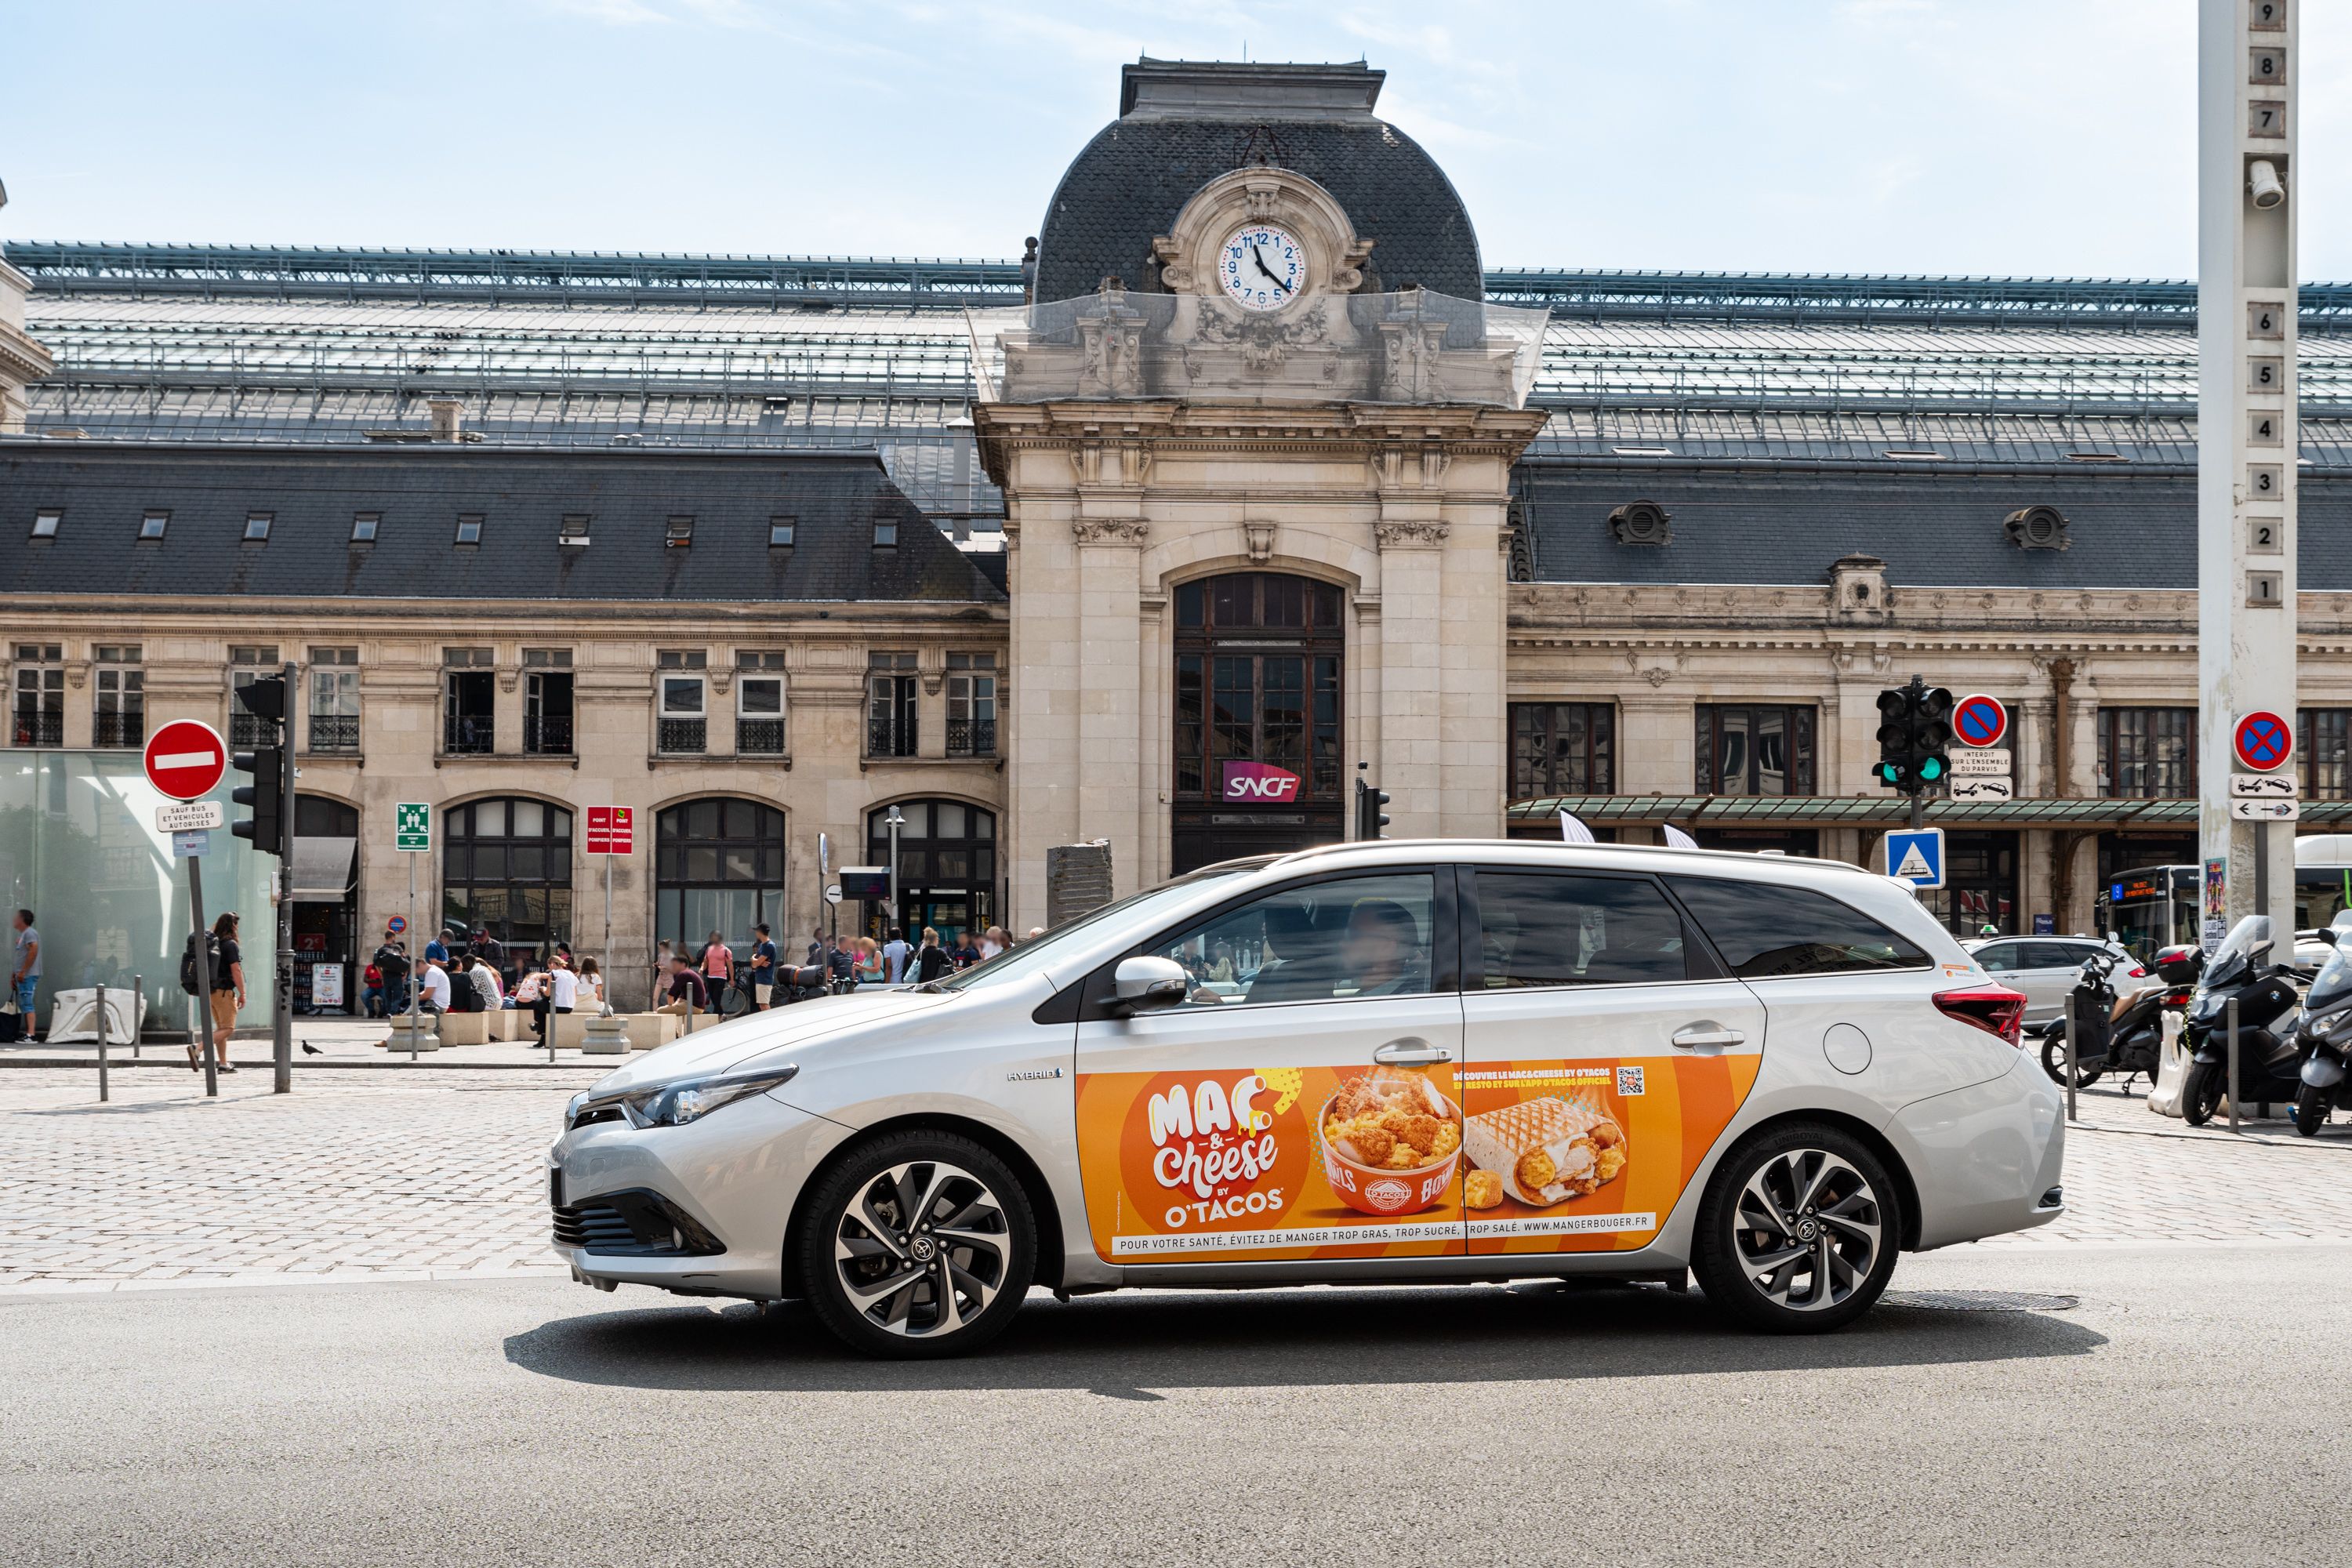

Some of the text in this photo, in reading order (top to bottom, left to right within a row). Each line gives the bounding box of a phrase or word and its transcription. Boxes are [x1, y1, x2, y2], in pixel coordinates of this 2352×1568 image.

[2262, 3, 2273, 20] 9
[2262, 57, 2273, 75] 8
[2262, 111, 2273, 128] 7
[1242, 236, 1252, 248] 11
[1256, 233, 1269, 245] 12
[1274, 236, 1279, 248] 1
[1230, 247, 1243, 259] 10
[1284, 247, 1293, 259] 2
[1229, 261, 1236, 274] 9
[1288, 263, 1297, 275] 3
[1232, 276, 1241, 289] 8
[1244, 288, 1252, 297] 7
[1258, 292, 1266, 304] 6
[1274, 289, 1282, 301] 5
[2260, 313, 2270, 330] 6
[2260, 366, 2270, 383] 5
[2259, 420, 2270, 437] 4
[2259, 474, 2270, 491] 3
[2258, 528, 2270, 545] 2
[2260, 581, 2268, 597] 1
[1227, 777, 1296, 797] SNCF
[173, 812, 215, 821] VEHICULES
[169, 820, 210, 829] AUTORISES
[1007, 1070, 1054, 1081] HYBRID
[1453, 1070, 1497, 1081] DÉCOUVRE
[1498, 1071, 1508, 1080] LE
[1565, 1069, 1575, 1077] BY
[1576, 1067, 1610, 1076] O'TACOS
[1465, 1080, 1493, 1089] RESTO
[1504, 1080, 1521, 1088] SUR
[1521, 1079, 1542, 1087] L'APP
[1543, 1078, 1576, 1087] O'TACOS
[1577, 1076, 1611, 1085] OFFICIEL
[1148, 1075, 1272, 1147] MAC
[1153, 1134, 1278, 1199] Cheese
[1217, 1187, 1229, 1196] BY
[1165, 1189, 1283, 1229] O'TACOS
[1120, 1240, 1149, 1250] POUR
[1152, 1238, 1185, 1248] VOTRE
[1189, 1235, 1225, 1247] SANTÉ,
[1230, 1232, 1265, 1245] ÉVITEZ
[1269, 1234, 1283, 1243] DE
[1286, 1232, 1329, 1242] MANGER
[1332, 1231, 1359, 1240] TROP
[1362, 1229, 1392, 1240] GRAS,
[1396, 1228, 1421, 1237] TROP
[1425, 1224, 1460, 1236] SUCRÉ,
[1493, 1221, 1520, 1232] SALÉ.
[1524, 1217, 1647, 1232] WWW.MANGERBOUGER.FR
